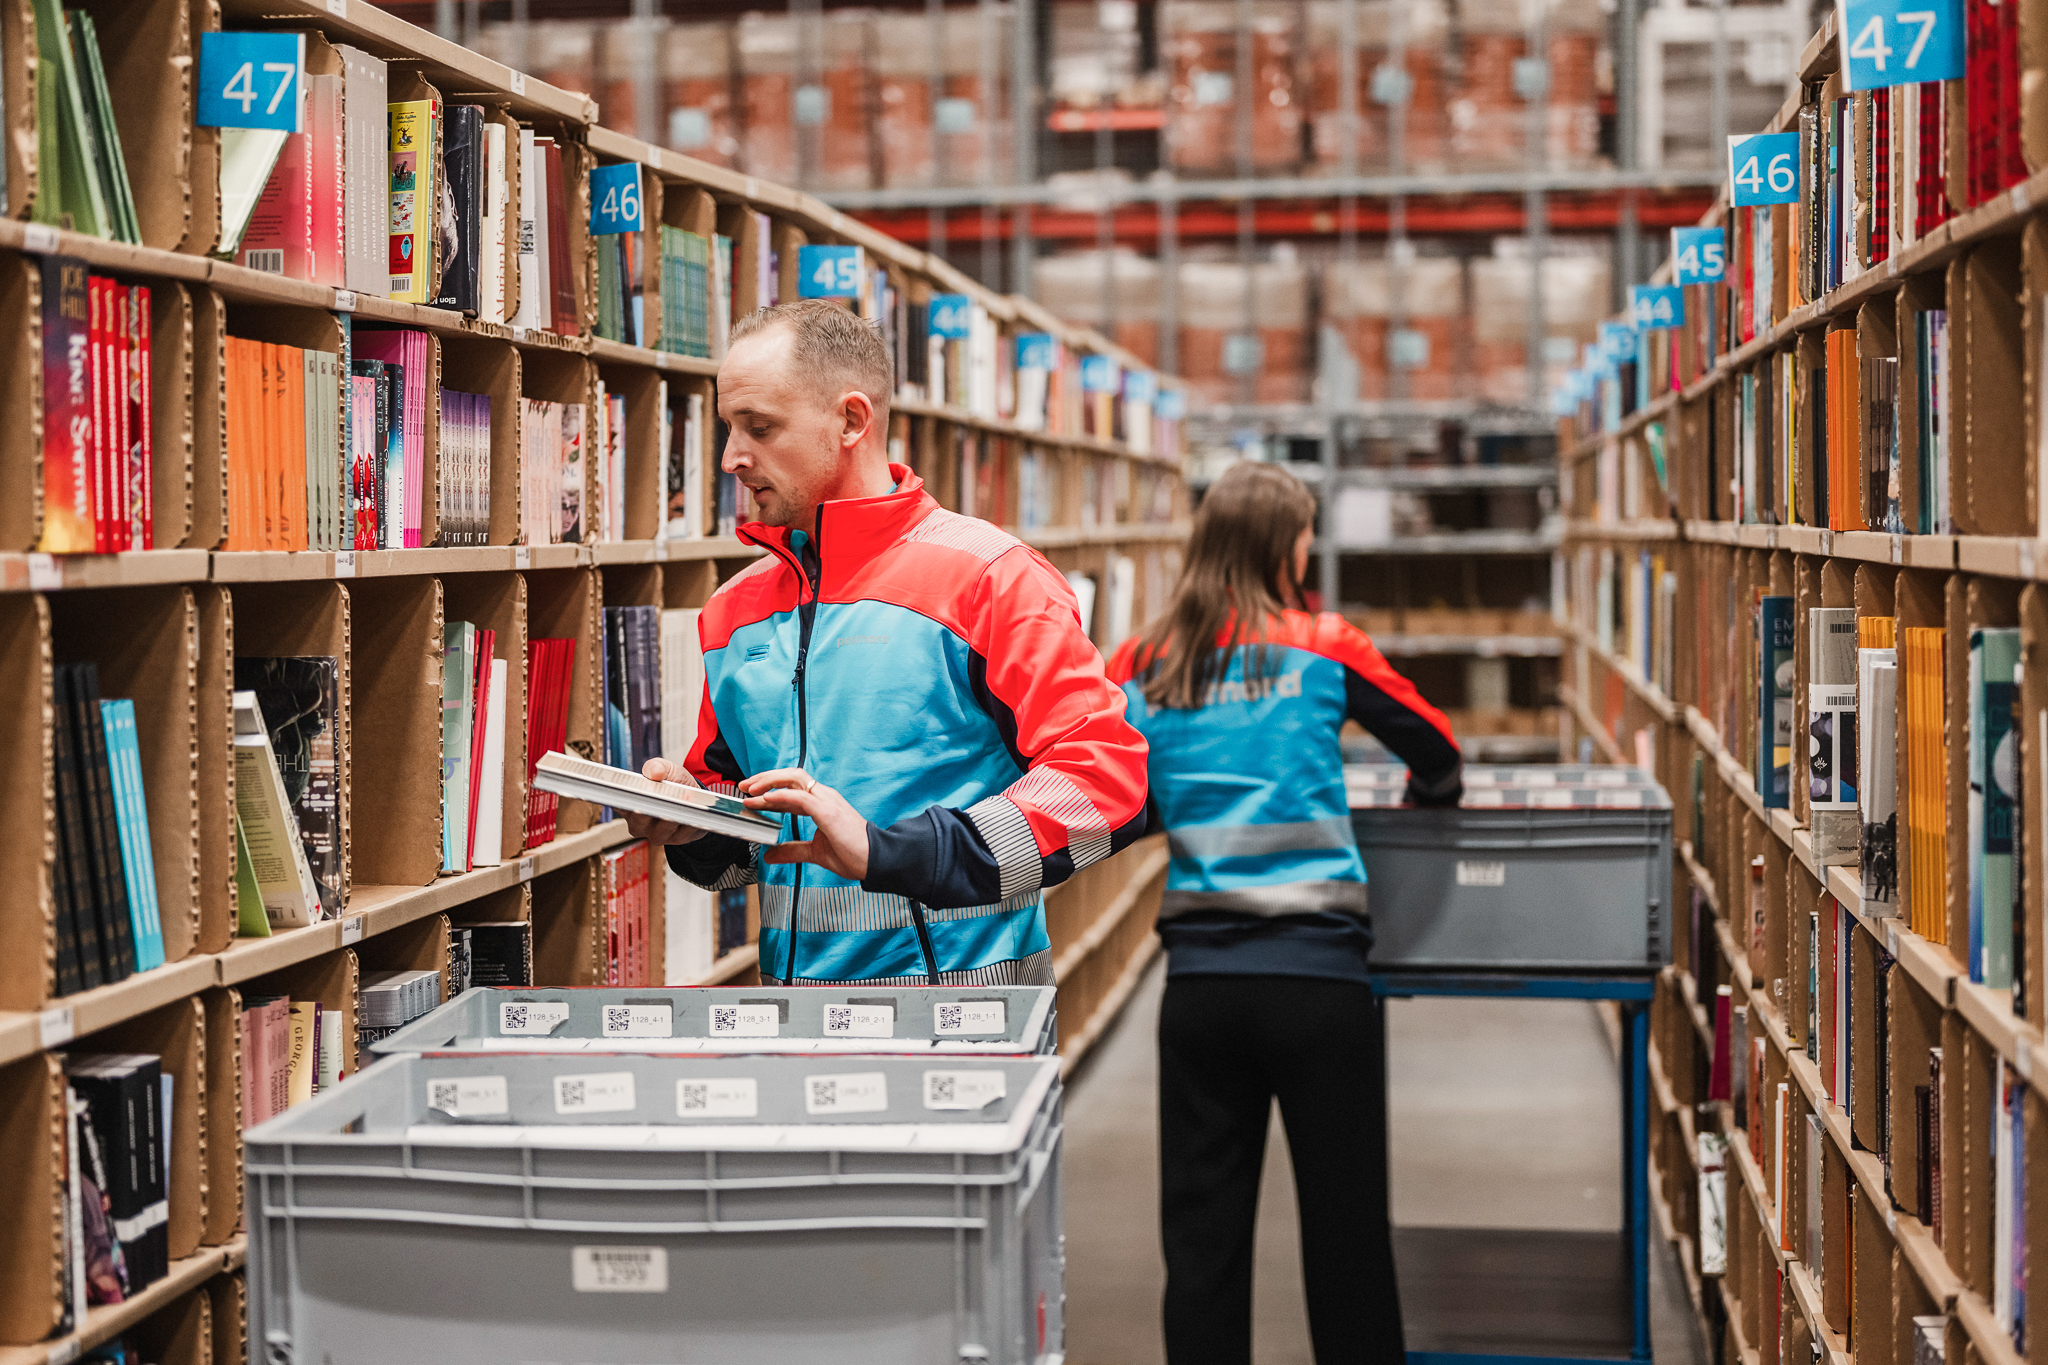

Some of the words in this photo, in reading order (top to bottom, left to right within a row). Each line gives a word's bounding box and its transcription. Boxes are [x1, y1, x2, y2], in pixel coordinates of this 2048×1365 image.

[1849, 11, 1937, 71] 47
[222, 61, 296, 115] 47
[335, 135, 343, 203] FEMININ
[1734, 153, 1795, 194] 46
[496, 191, 505, 247] Keyes
[601, 183, 639, 223] 46
[336, 205, 344, 258] KRAFT
[813, 257, 857, 290] 45
[1678, 243, 1724, 277] 45
[439, 297, 457, 305] Elon
[496, 253, 505, 317] Marian
[836, 634, 889, 648] postnord
[528, 1013, 561, 1024] 1128_5-1
[631, 1015, 664, 1025] 1128_4-1
[738, 1015, 771, 1025] 1128_3-1
[852, 1016, 885, 1026] 1128_2-1
[963, 1012, 996, 1023] 1128_1-1
